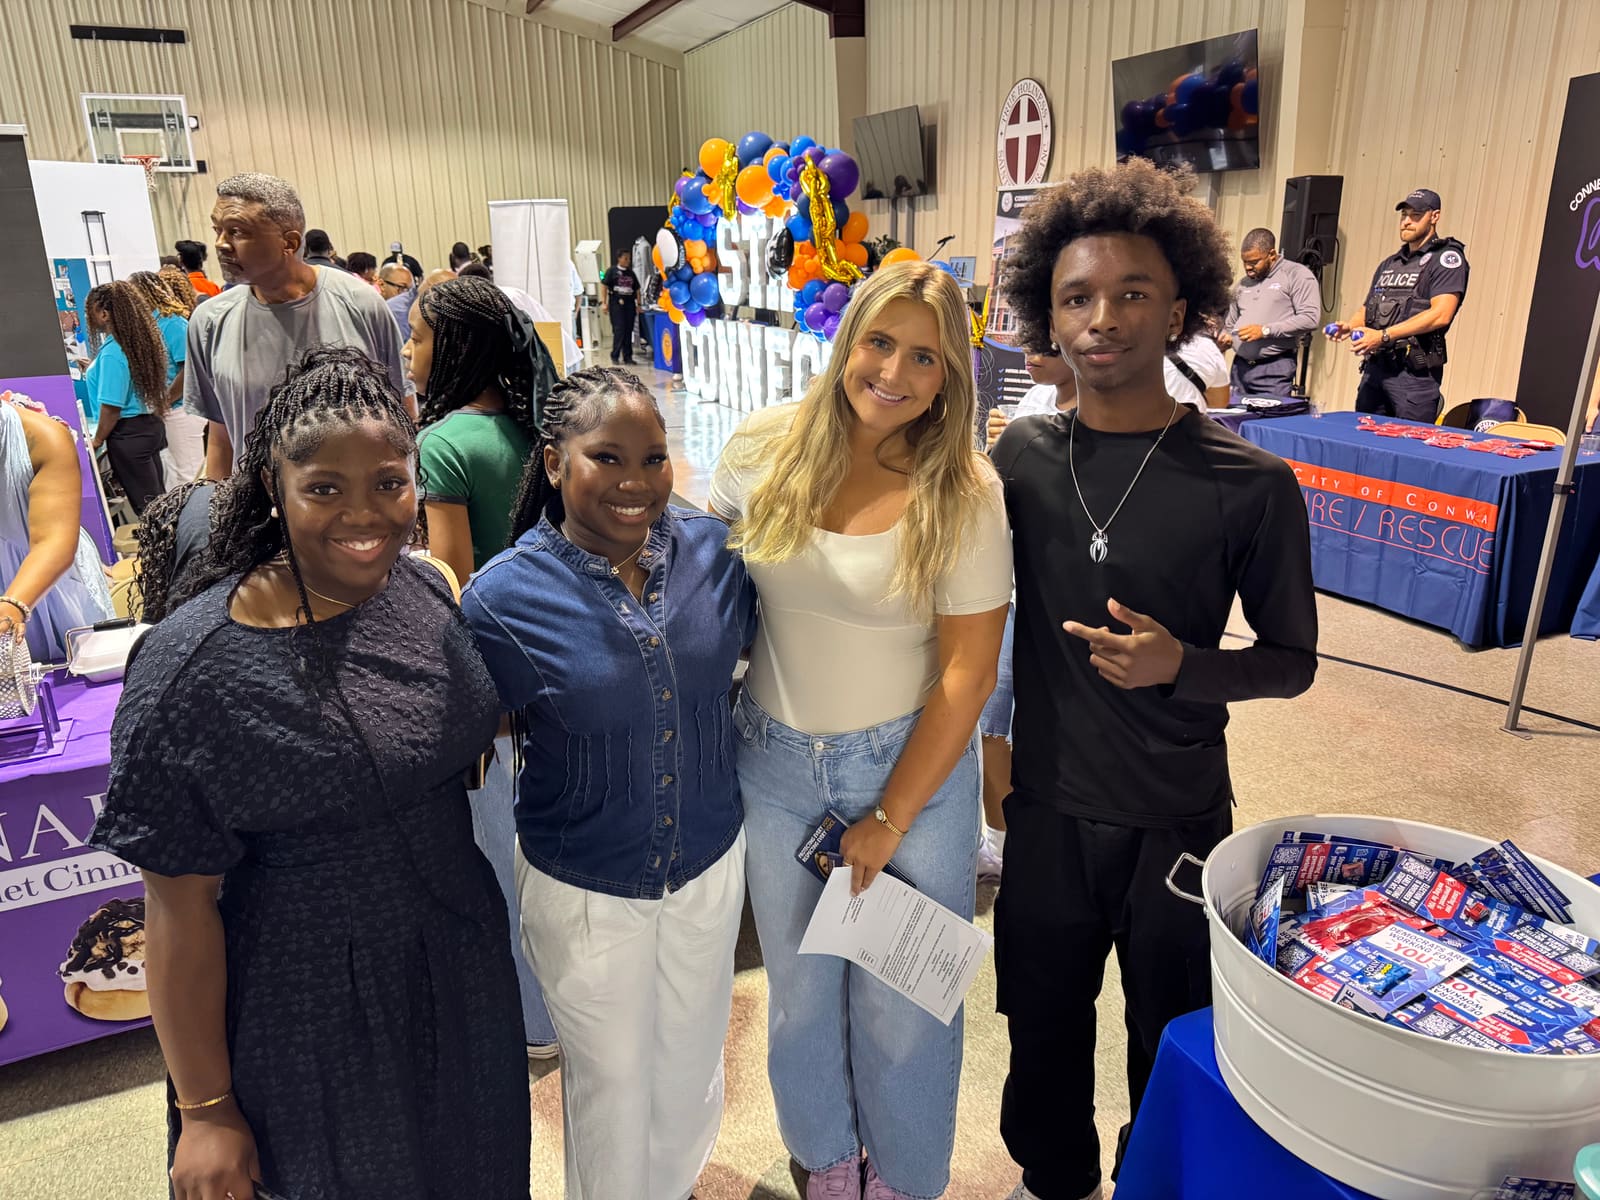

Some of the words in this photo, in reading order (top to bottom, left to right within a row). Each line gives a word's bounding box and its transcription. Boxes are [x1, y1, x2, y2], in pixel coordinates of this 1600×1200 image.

[1376, 273, 1419, 287] POLICE
[679, 318, 836, 412] CONNEC
[1294, 468, 1340, 489] CITY
[1361, 486, 1384, 499] OF
[1304, 490, 1345, 526] IRE
[1378, 509, 1496, 569] RESCUE
[1388, 925, 1446, 953] DEMOCRATS
[1445, 951, 1467, 963] ARE
[1389, 931, 1432, 953] WORKING
[1432, 951, 1453, 963] FOR
[1393, 941, 1433, 966] YOU
[1433, 988, 1482, 1016] DEMOCRA
[1462, 1026, 1498, 1047] ELECTION
